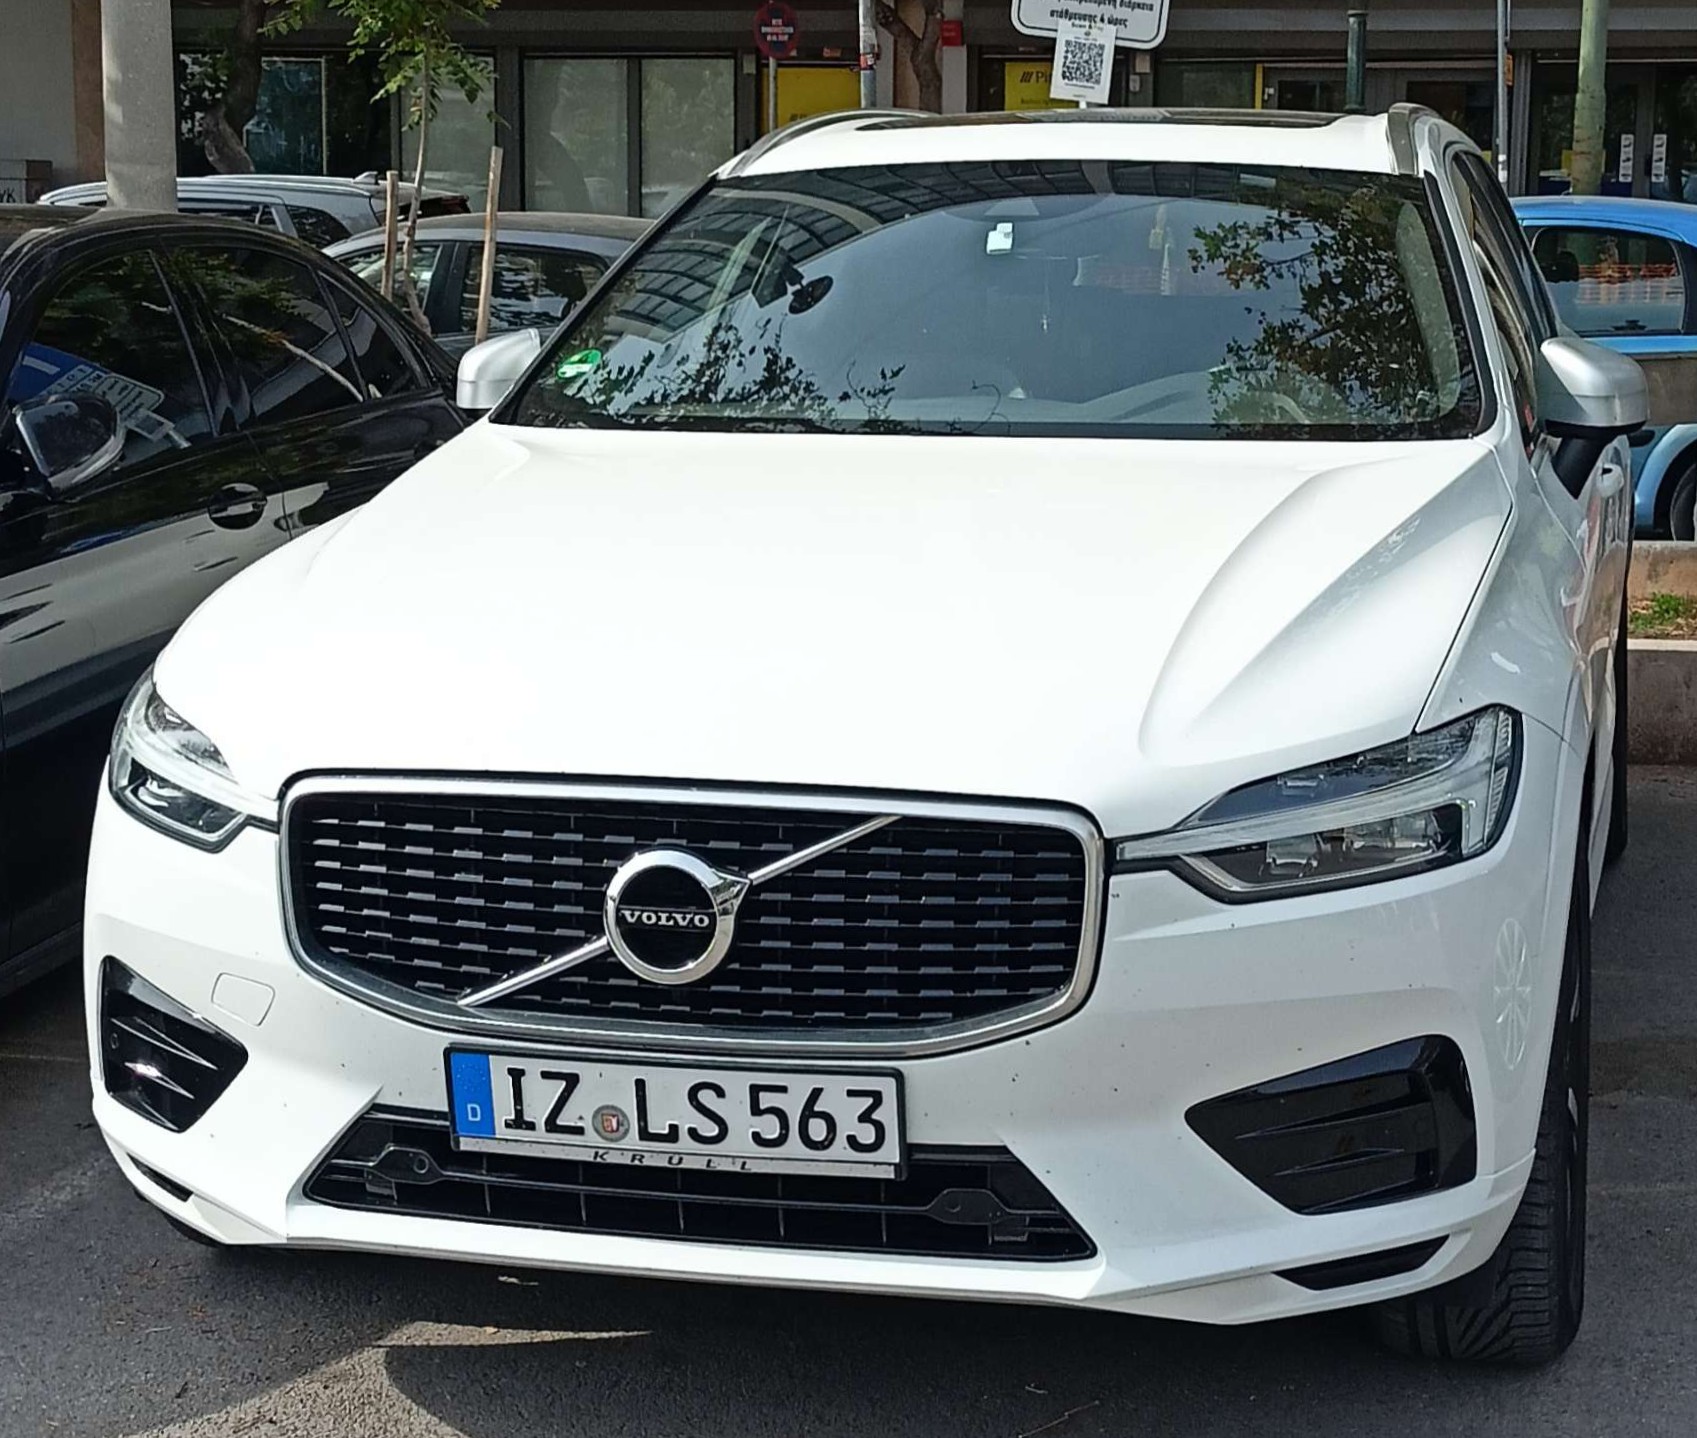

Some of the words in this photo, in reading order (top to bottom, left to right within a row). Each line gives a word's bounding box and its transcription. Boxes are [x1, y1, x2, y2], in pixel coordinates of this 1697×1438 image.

[620, 910, 710, 927] VOLVO
[467, 1103, 481, 1121] D
[504, 1067, 586, 1136] IZ
[634, 1078, 728, 1145] LS
[749, 1083, 886, 1154] 563
